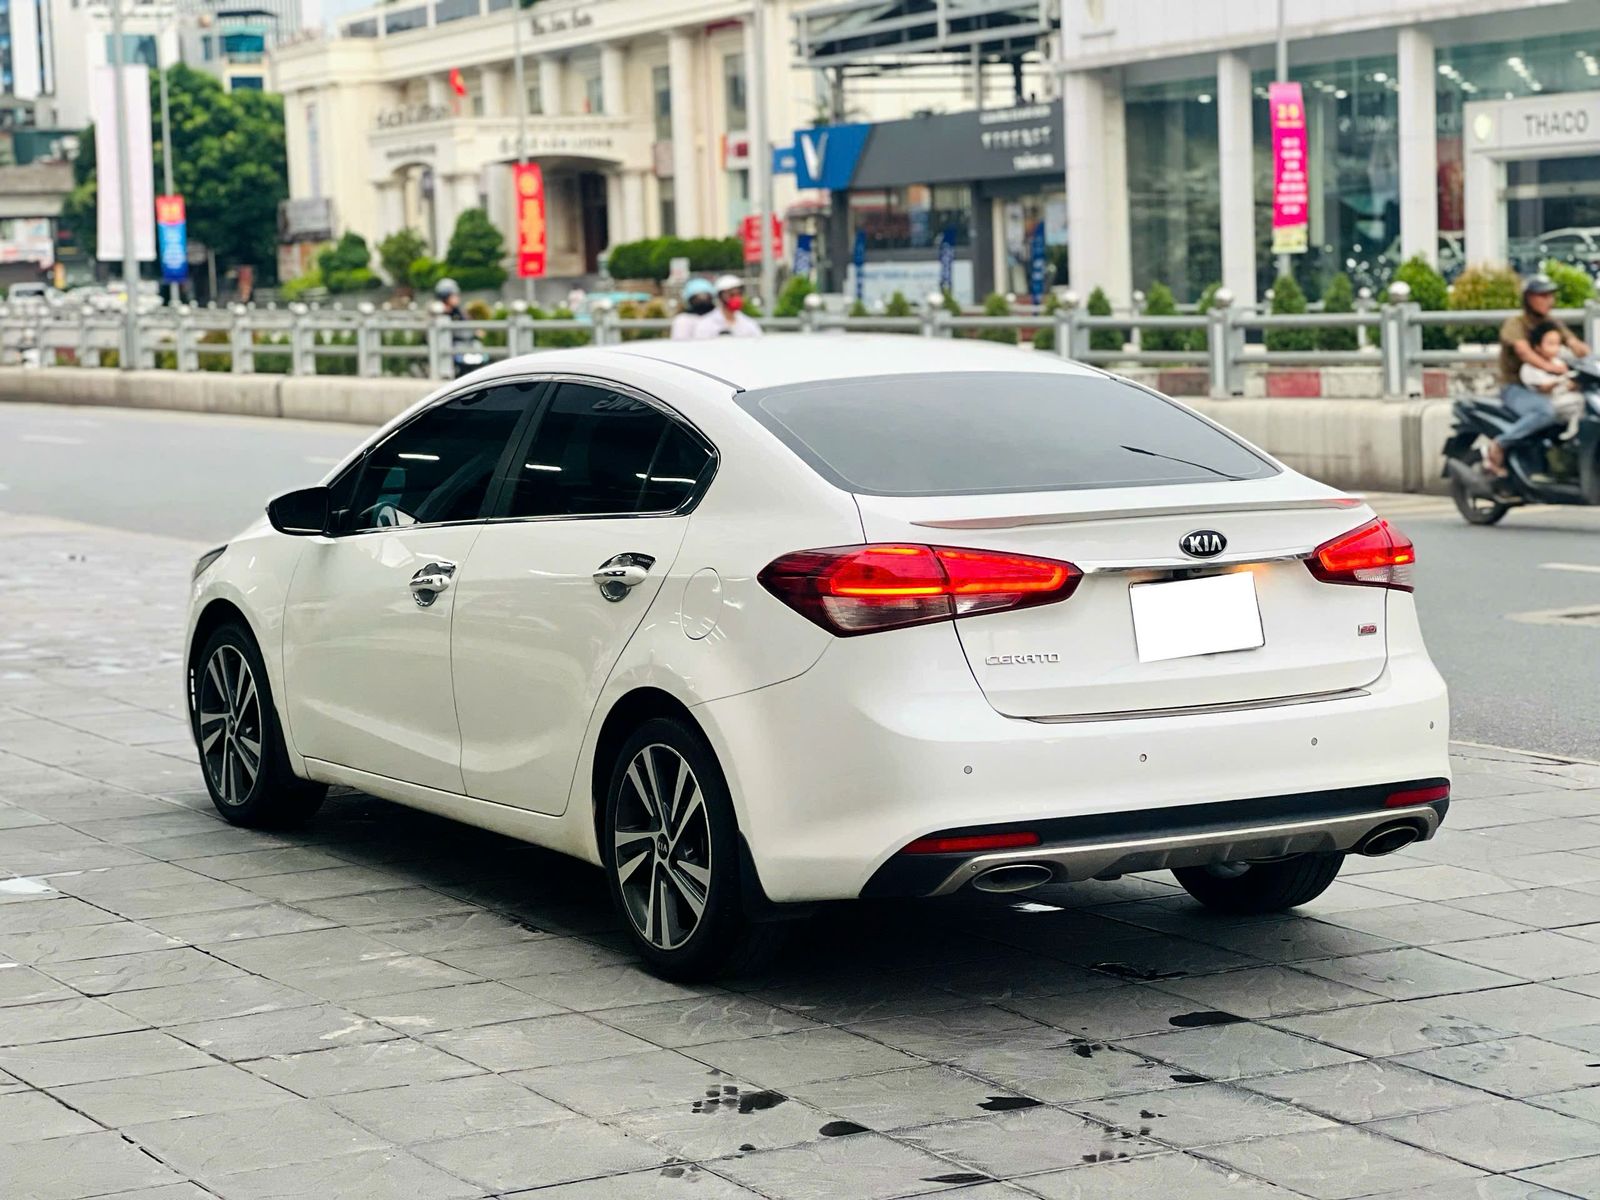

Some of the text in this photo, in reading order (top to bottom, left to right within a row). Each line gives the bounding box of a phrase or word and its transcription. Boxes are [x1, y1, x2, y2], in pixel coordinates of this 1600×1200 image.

[1523, 109, 1589, 137] THACO
[1188, 534, 1223, 553] KIA
[985, 653, 1061, 666] CERATO
